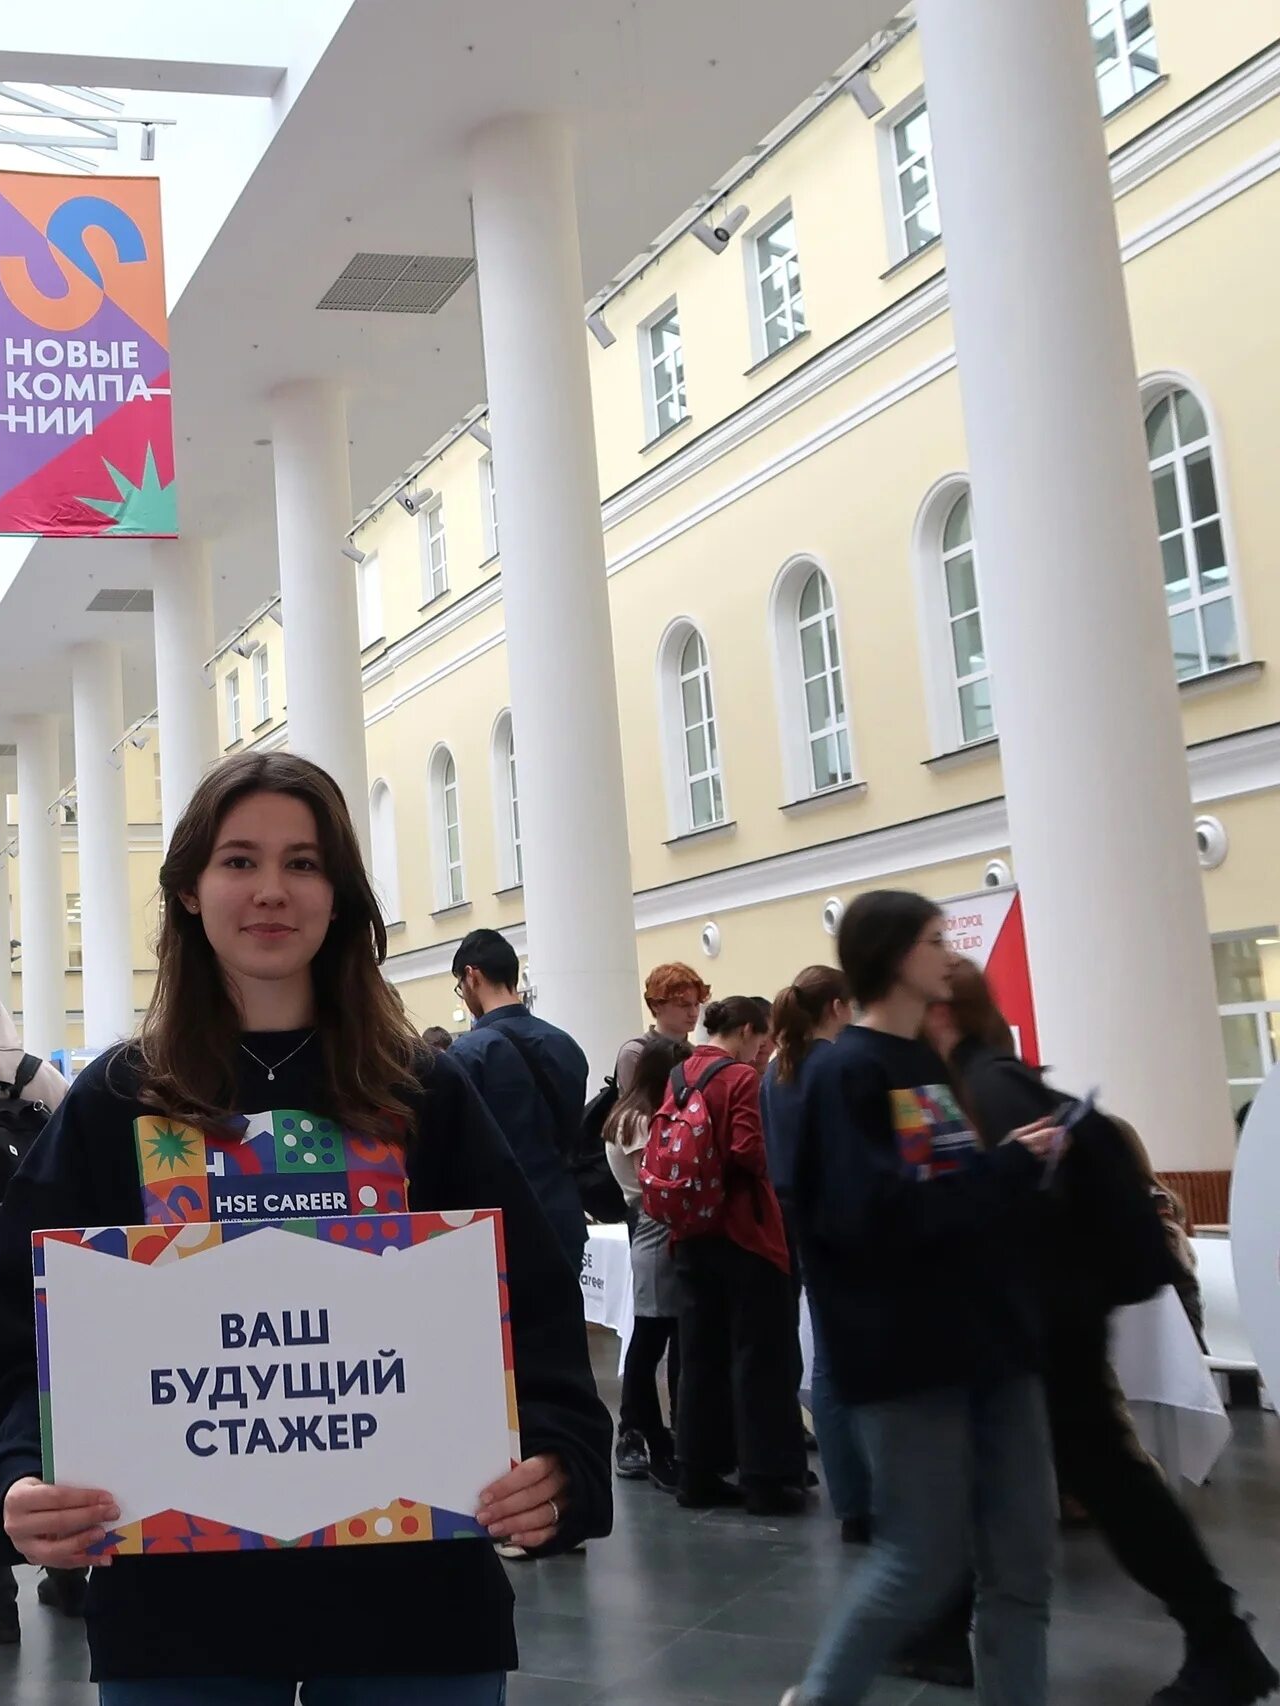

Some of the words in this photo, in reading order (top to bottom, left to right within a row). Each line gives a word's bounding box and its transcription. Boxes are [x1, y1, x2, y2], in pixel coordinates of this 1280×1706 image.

[5, 337, 139, 369] НОВЫЕ
[215, 1194, 258, 1214] HSE
[263, 1192, 348, 1212] CAREER
[220, 1308, 330, 1349] ВАШ
[150, 1348, 406, 1411] БУДУЩИЙ
[185, 1413, 378, 1457] СТАЖЕР
